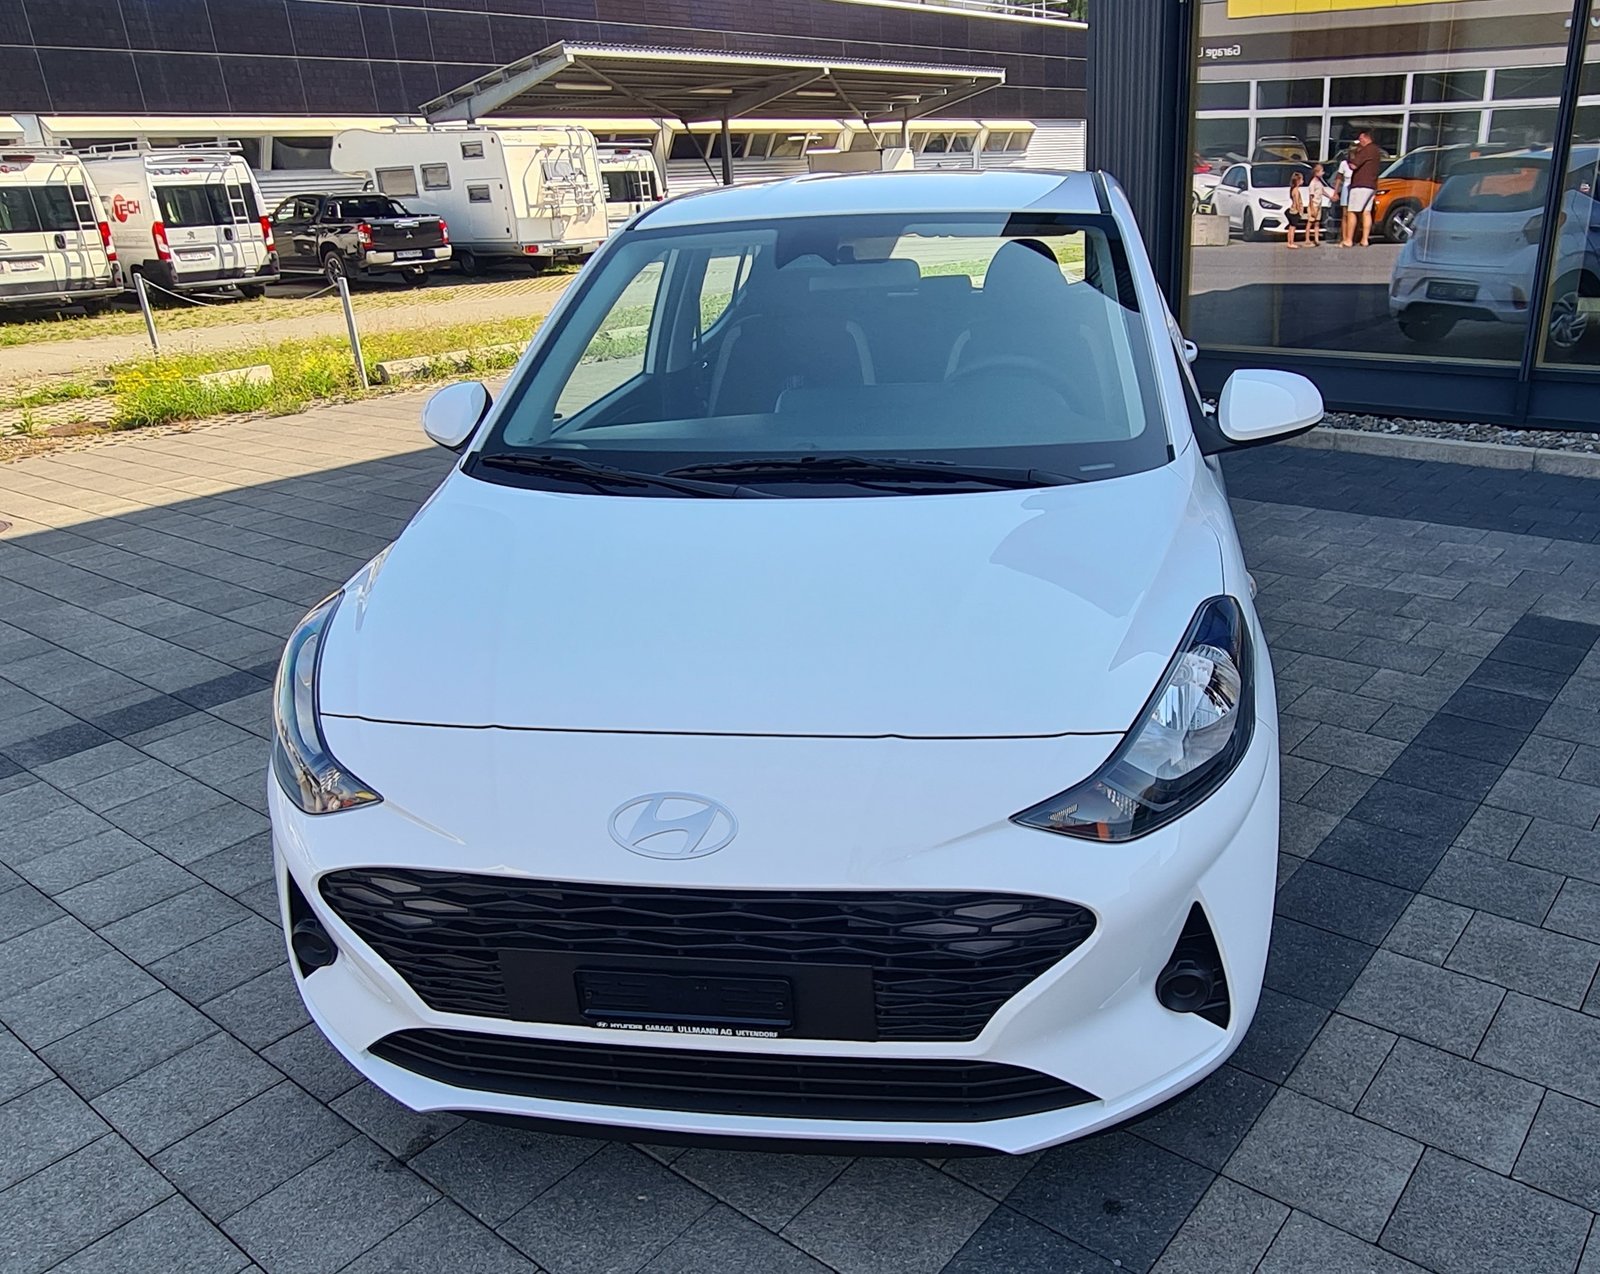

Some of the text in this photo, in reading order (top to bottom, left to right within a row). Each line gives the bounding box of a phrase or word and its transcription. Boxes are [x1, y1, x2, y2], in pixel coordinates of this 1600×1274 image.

[645, 1024, 674, 1033] GARAGE
[677, 1025, 719, 1035] ULLMANN
[720, 1028, 733, 1036] AG
[735, 1029, 779, 1038] UETENDORF
